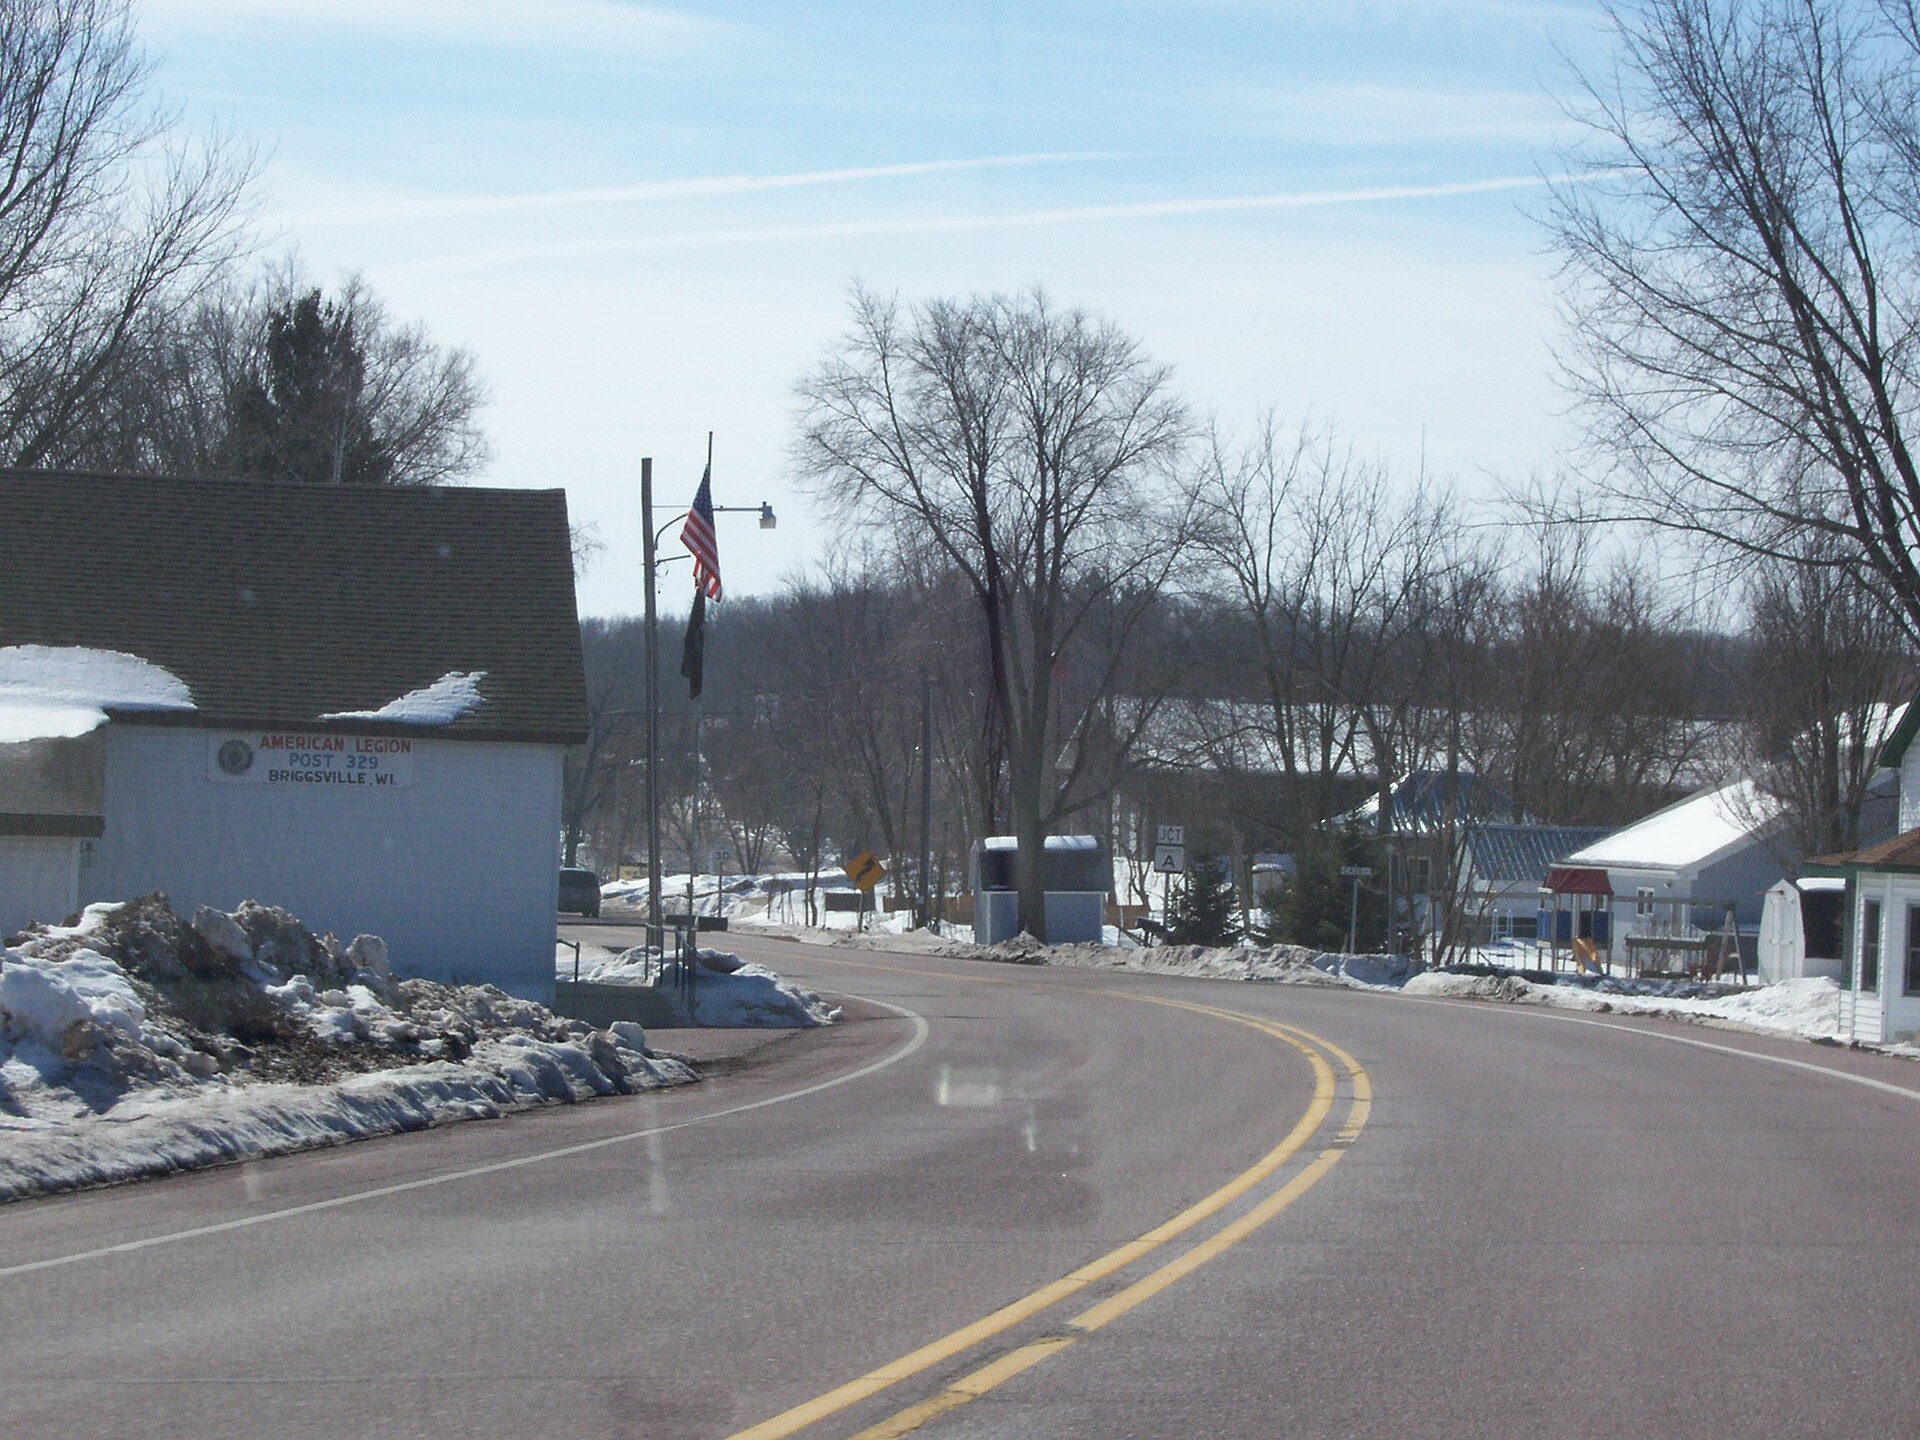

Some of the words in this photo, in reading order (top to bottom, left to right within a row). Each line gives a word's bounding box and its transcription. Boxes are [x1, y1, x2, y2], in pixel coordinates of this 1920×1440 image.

[259, 735, 345, 751] AMERICAN
[355, 738, 412, 753] LEGION
[289, 752, 335, 768] POST
[346, 755, 379, 769] 329
[1158, 827, 1182, 841] JCT
[1162, 855, 1175, 868] A
